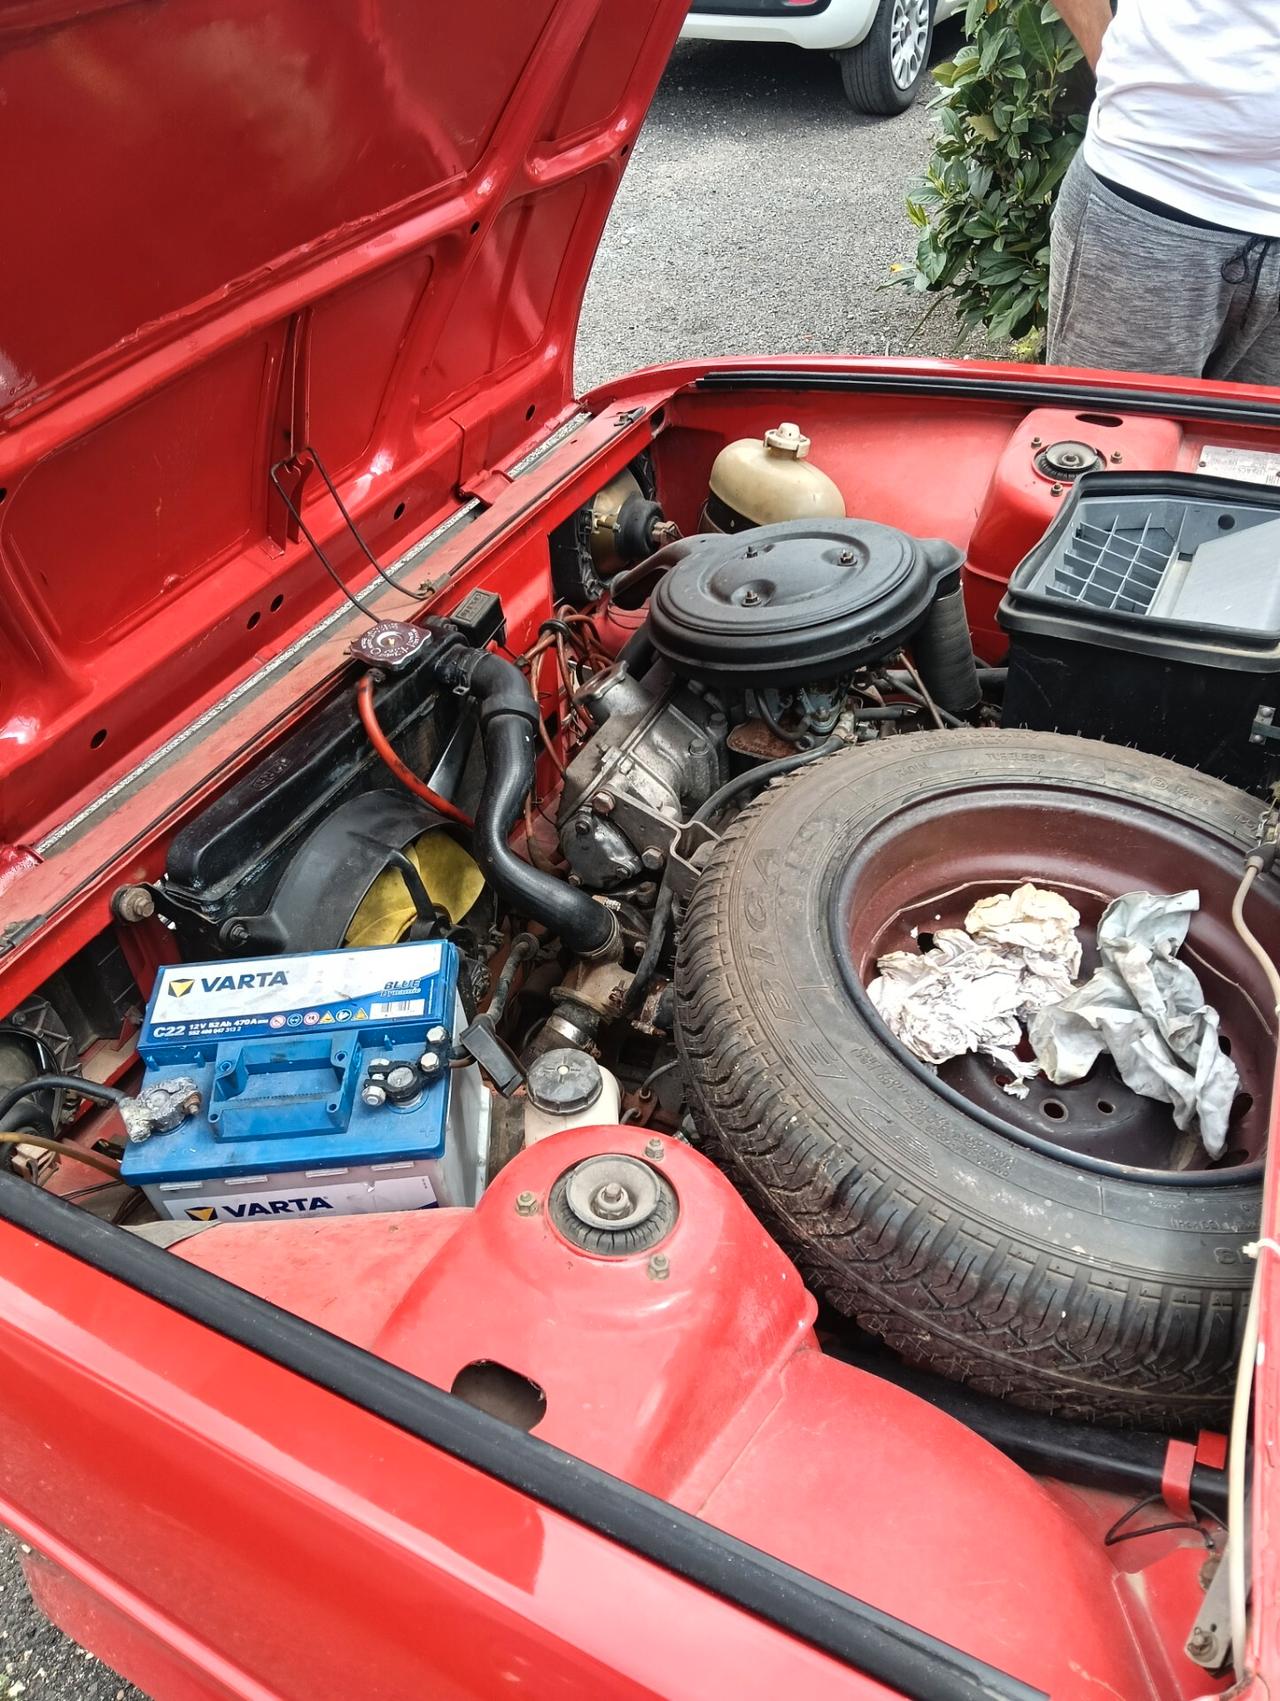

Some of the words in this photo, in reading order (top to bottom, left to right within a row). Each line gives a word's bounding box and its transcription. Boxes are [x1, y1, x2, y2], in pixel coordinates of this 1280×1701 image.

[201, 971, 288, 992] VARTA
[384, 979, 421, 990] BLUE
[153, 1025, 185, 1038] C22
[221, 1197, 333, 1217] VARTA
